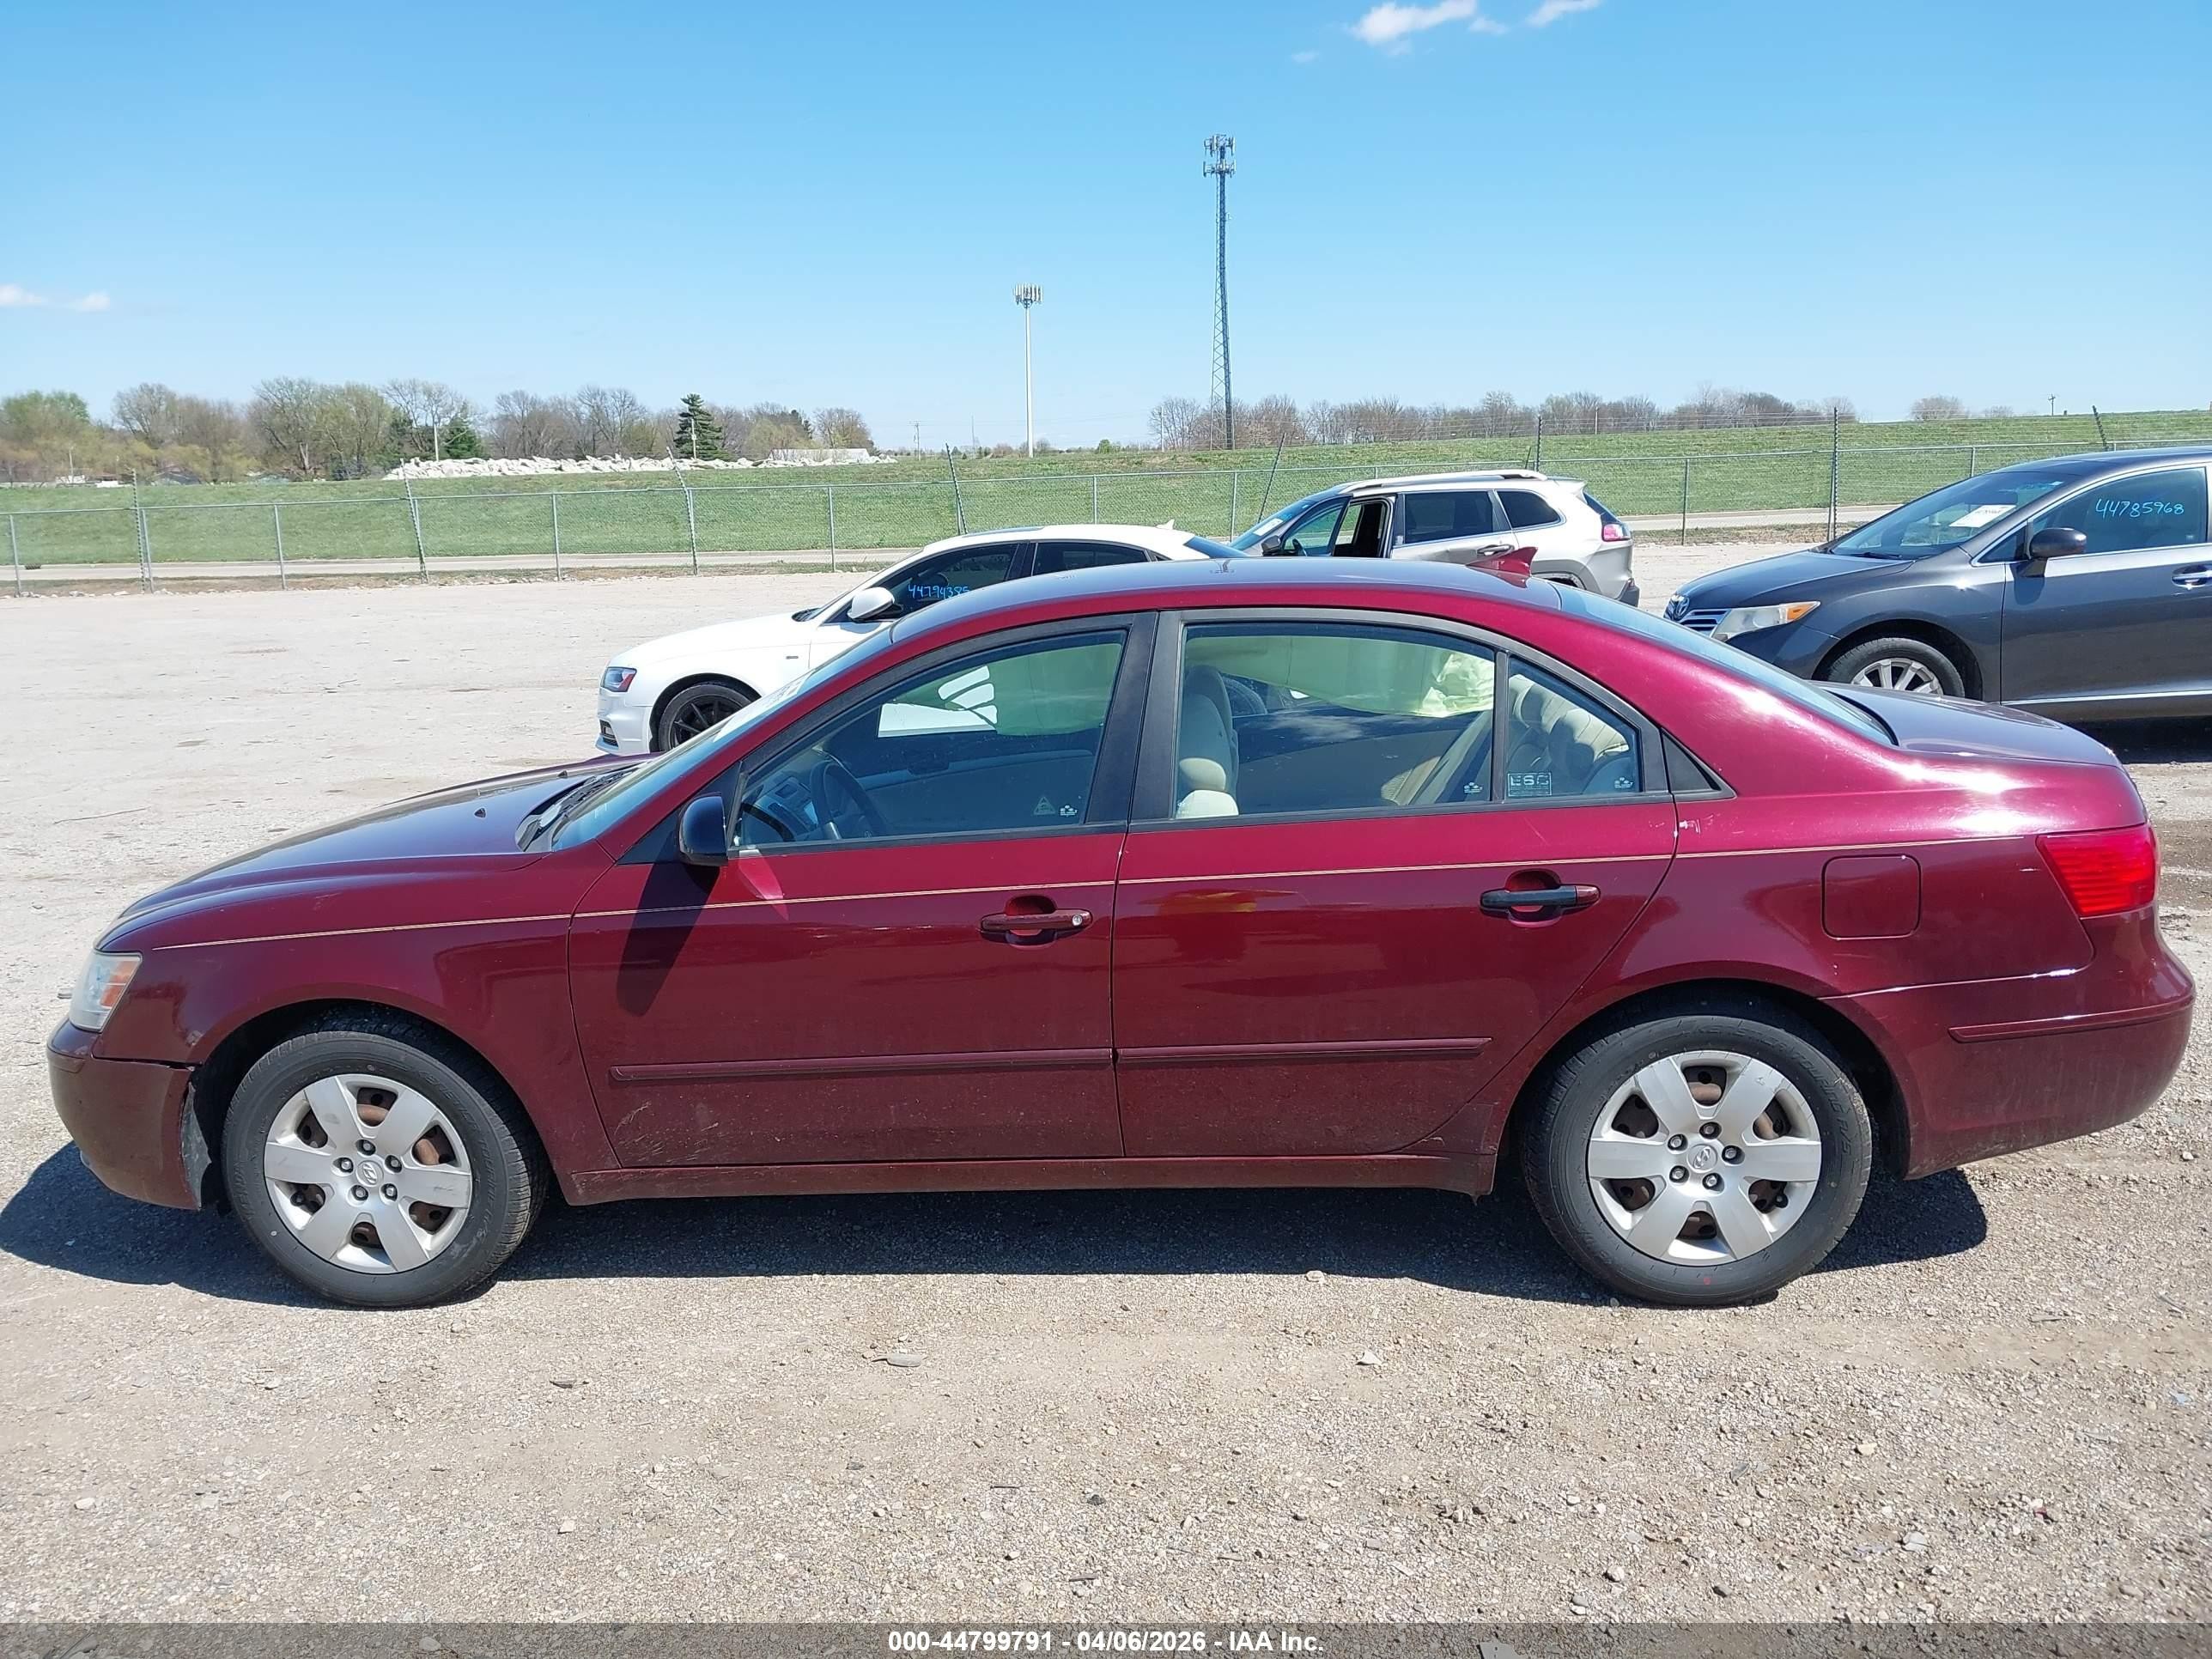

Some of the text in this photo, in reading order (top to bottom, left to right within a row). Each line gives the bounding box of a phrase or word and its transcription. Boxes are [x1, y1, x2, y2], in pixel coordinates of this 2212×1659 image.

[2095, 498, 2185, 519] 44785968
[1510, 775, 1549, 786] ESC
[1790, 1051, 1845, 1114] TOURING
